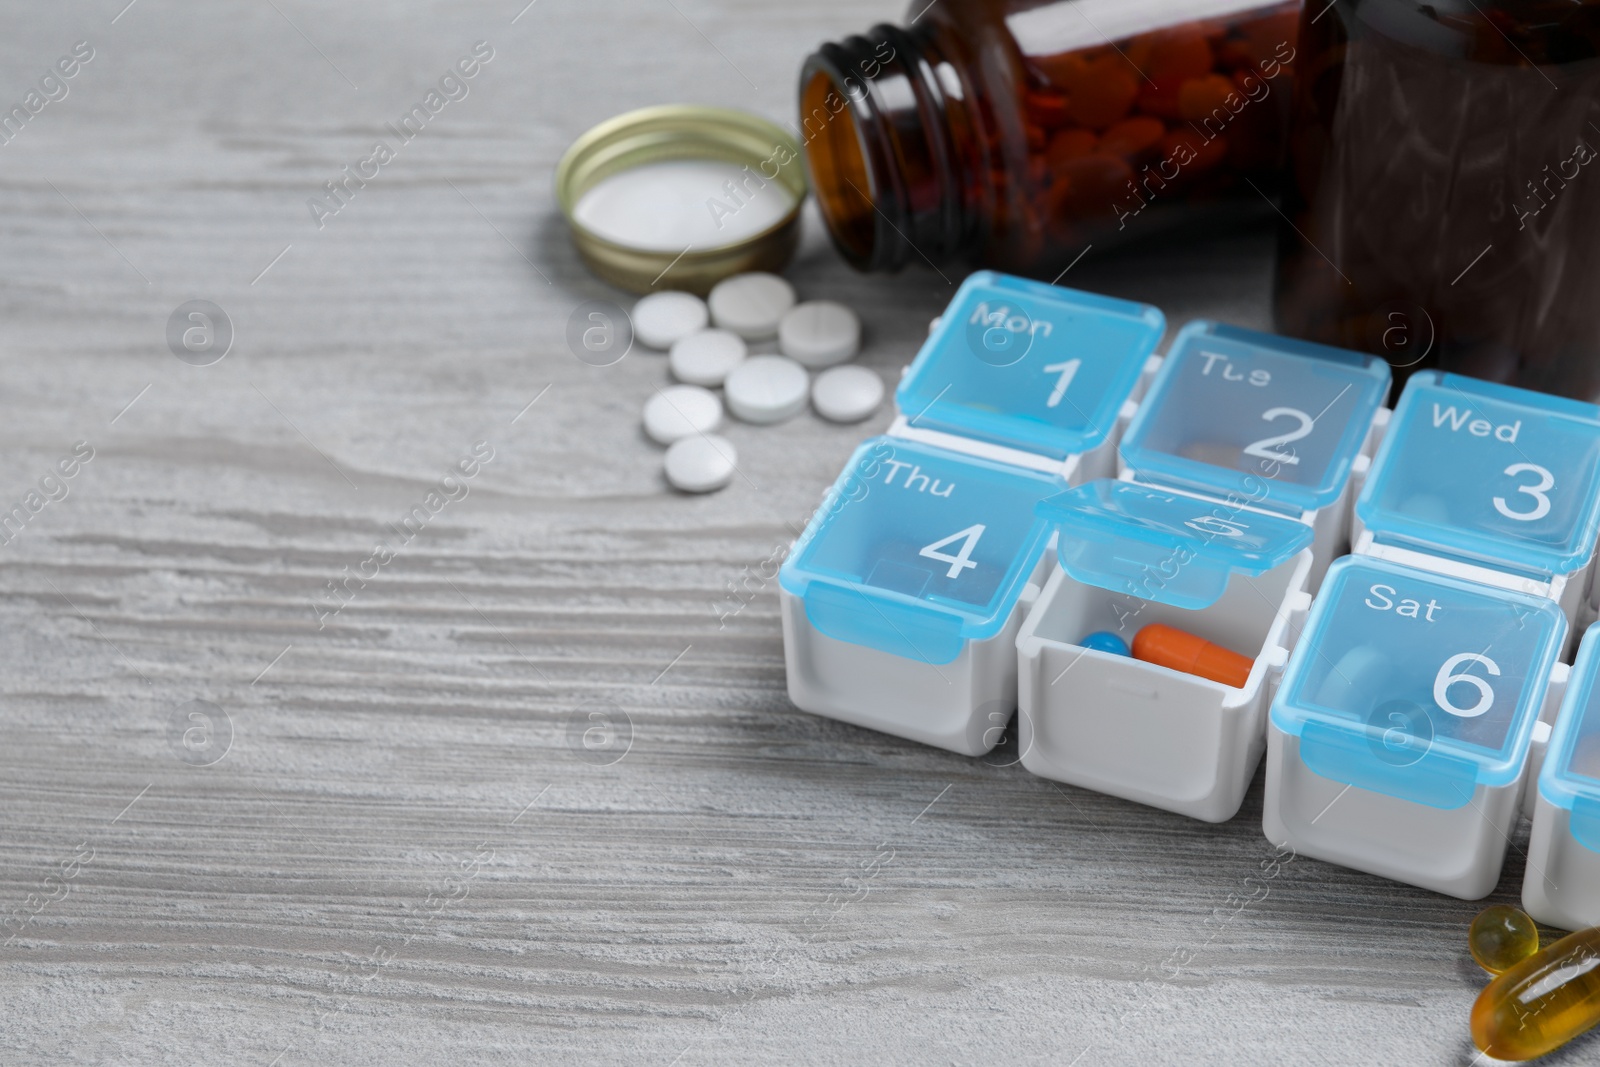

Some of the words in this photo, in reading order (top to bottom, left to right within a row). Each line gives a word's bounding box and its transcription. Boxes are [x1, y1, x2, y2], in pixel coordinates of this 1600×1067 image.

[969, 301, 1053, 338] Mon
[1043, 358, 1081, 408] 1
[1243, 407, 1314, 465] 2
[1433, 402, 1521, 443] Wed
[884, 459, 955, 498] Thu
[1118, 486, 1177, 503] Fri
[1493, 463, 1555, 521] 3
[1183, 514, 1250, 537] 5
[918, 523, 986, 579] 4
[1365, 584, 1442, 622] Sat
[1433, 652, 1501, 718] 6
